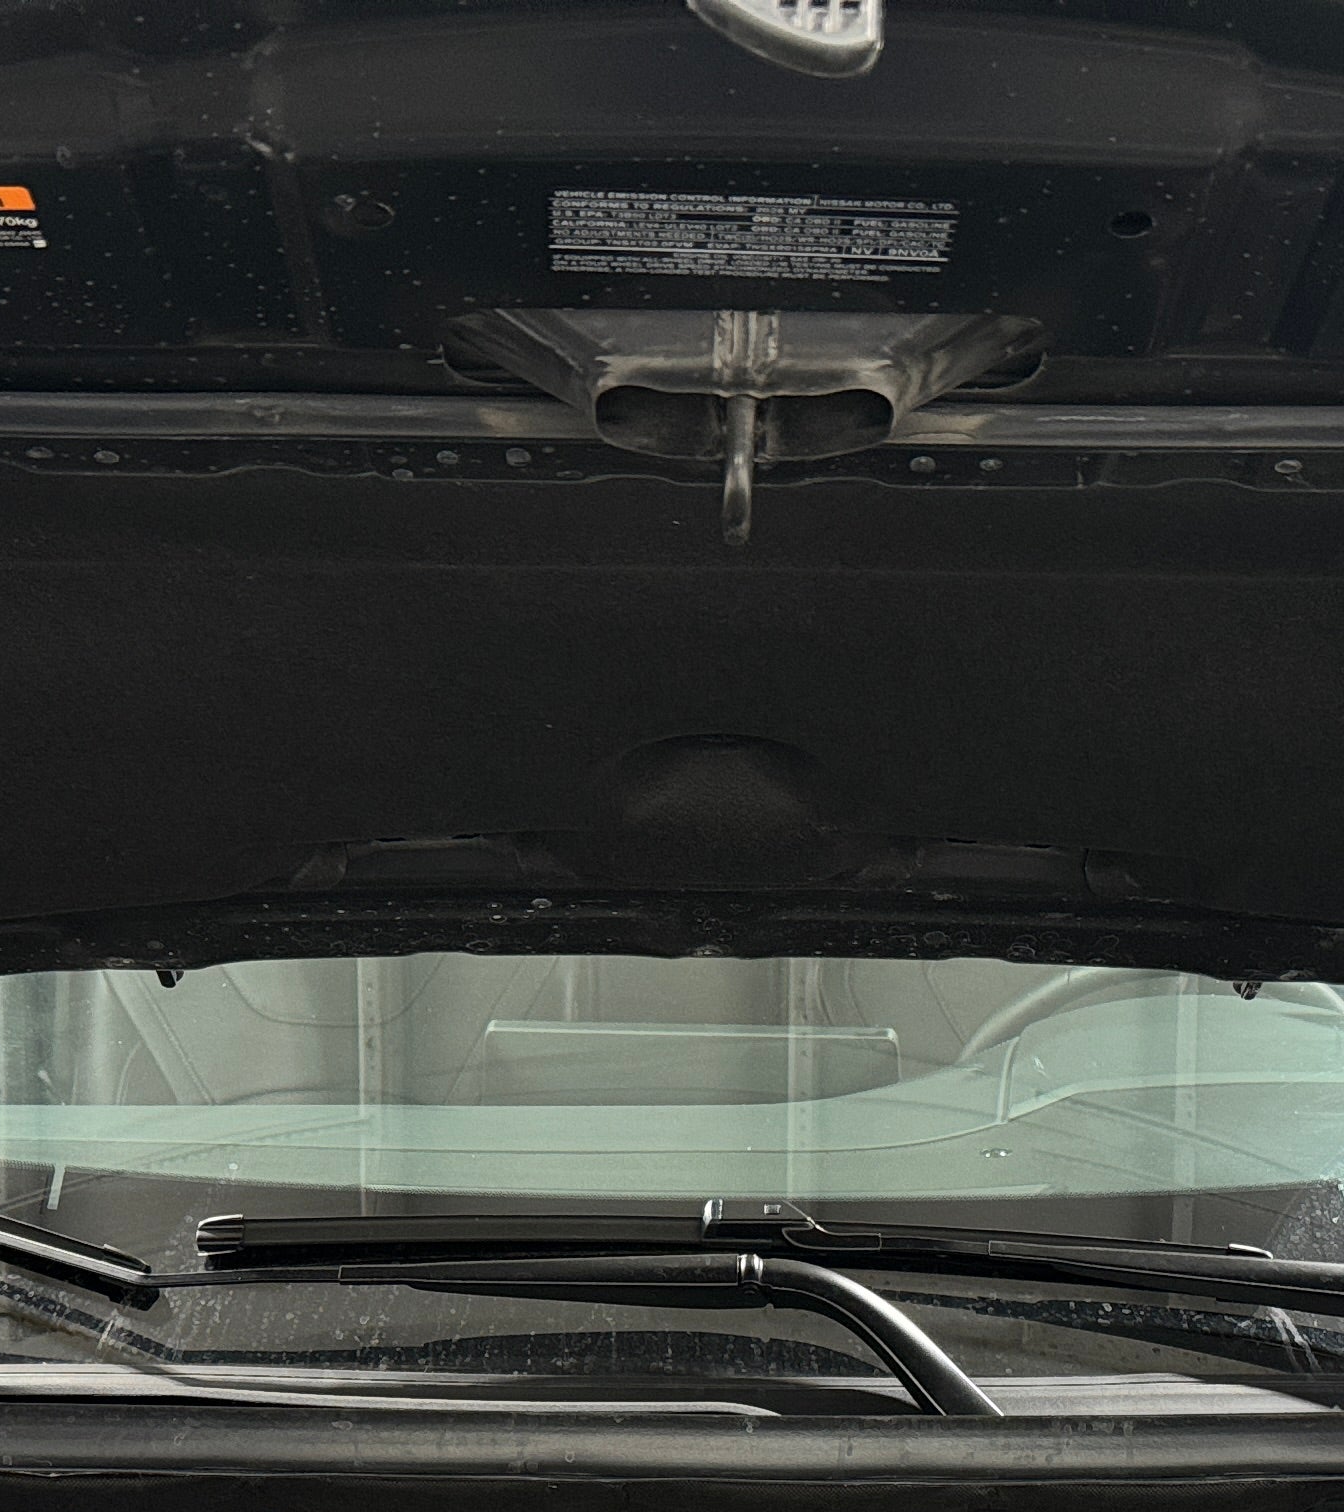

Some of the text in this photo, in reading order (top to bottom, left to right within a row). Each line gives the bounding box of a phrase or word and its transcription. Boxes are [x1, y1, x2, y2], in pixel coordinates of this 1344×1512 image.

[554, 190, 811, 205] VEHICLE EMISSION CONTROL INFORMATION
[552, 200, 629, 209] CONFORMS
[819, 199, 862, 208] NISSAN
[864, 201, 905, 209] MOTOR
[891, 222, 950, 230] GASOLINE
[889, 230, 948, 239] GASOLINE
[851, 247, 872, 256] NV
